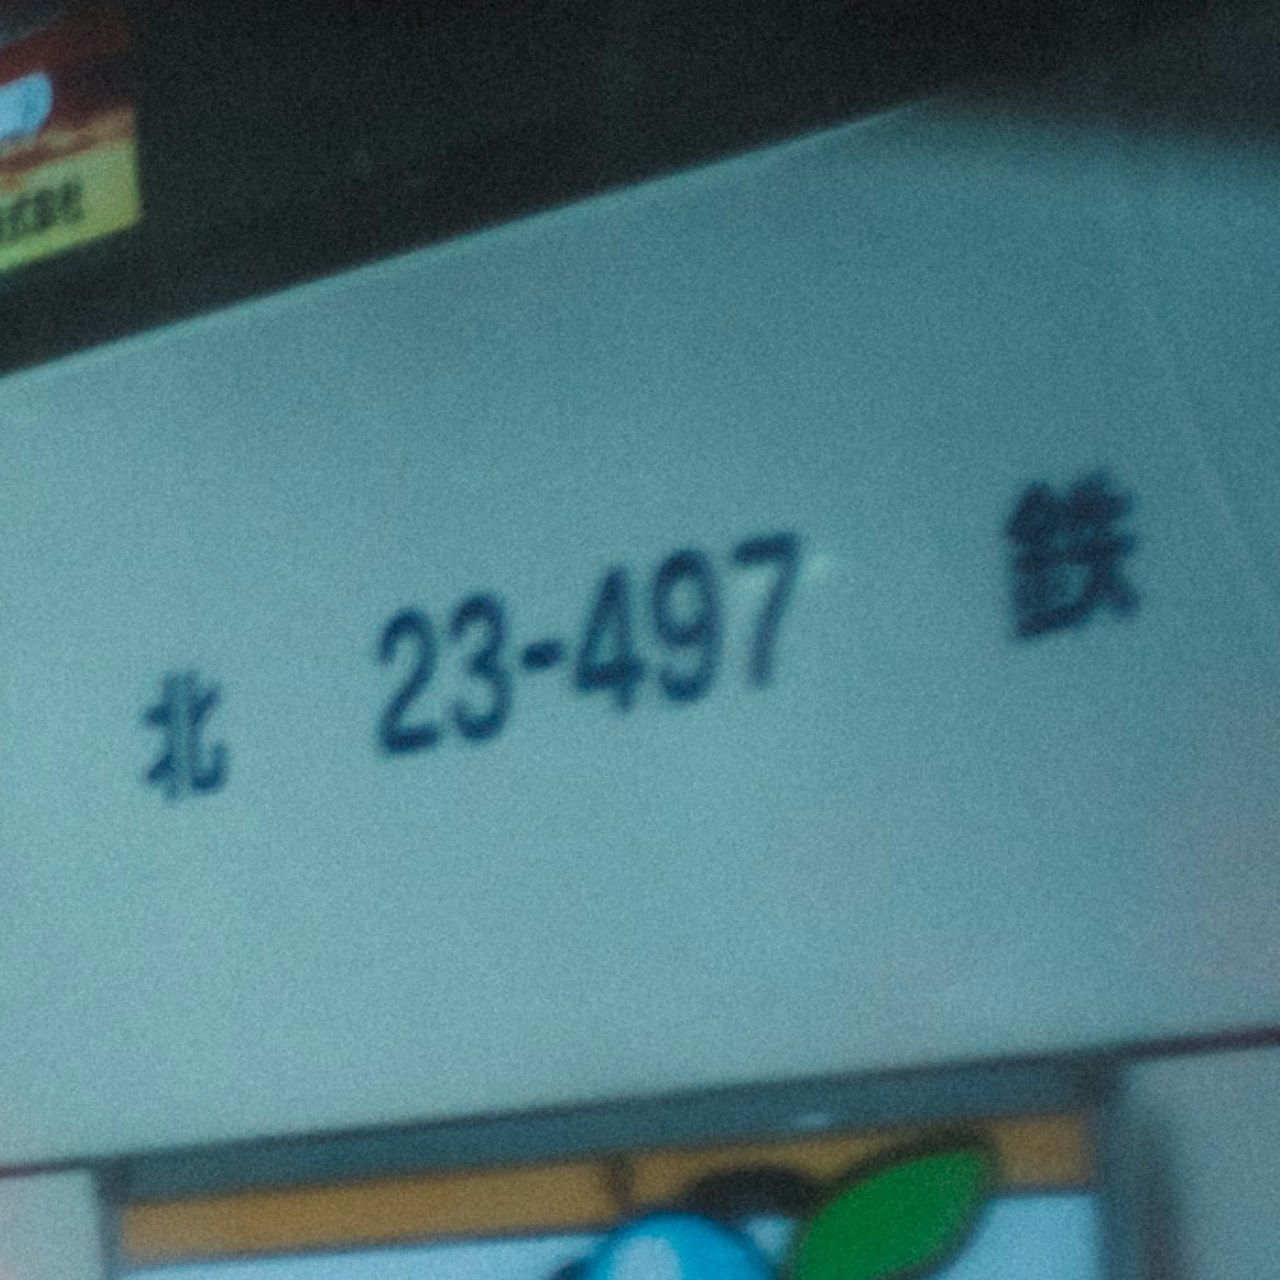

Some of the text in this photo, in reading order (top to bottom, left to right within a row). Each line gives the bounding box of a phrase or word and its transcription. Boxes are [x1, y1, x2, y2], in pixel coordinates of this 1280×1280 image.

[144, 470, 1140, 798] 北 23-497 鉄
